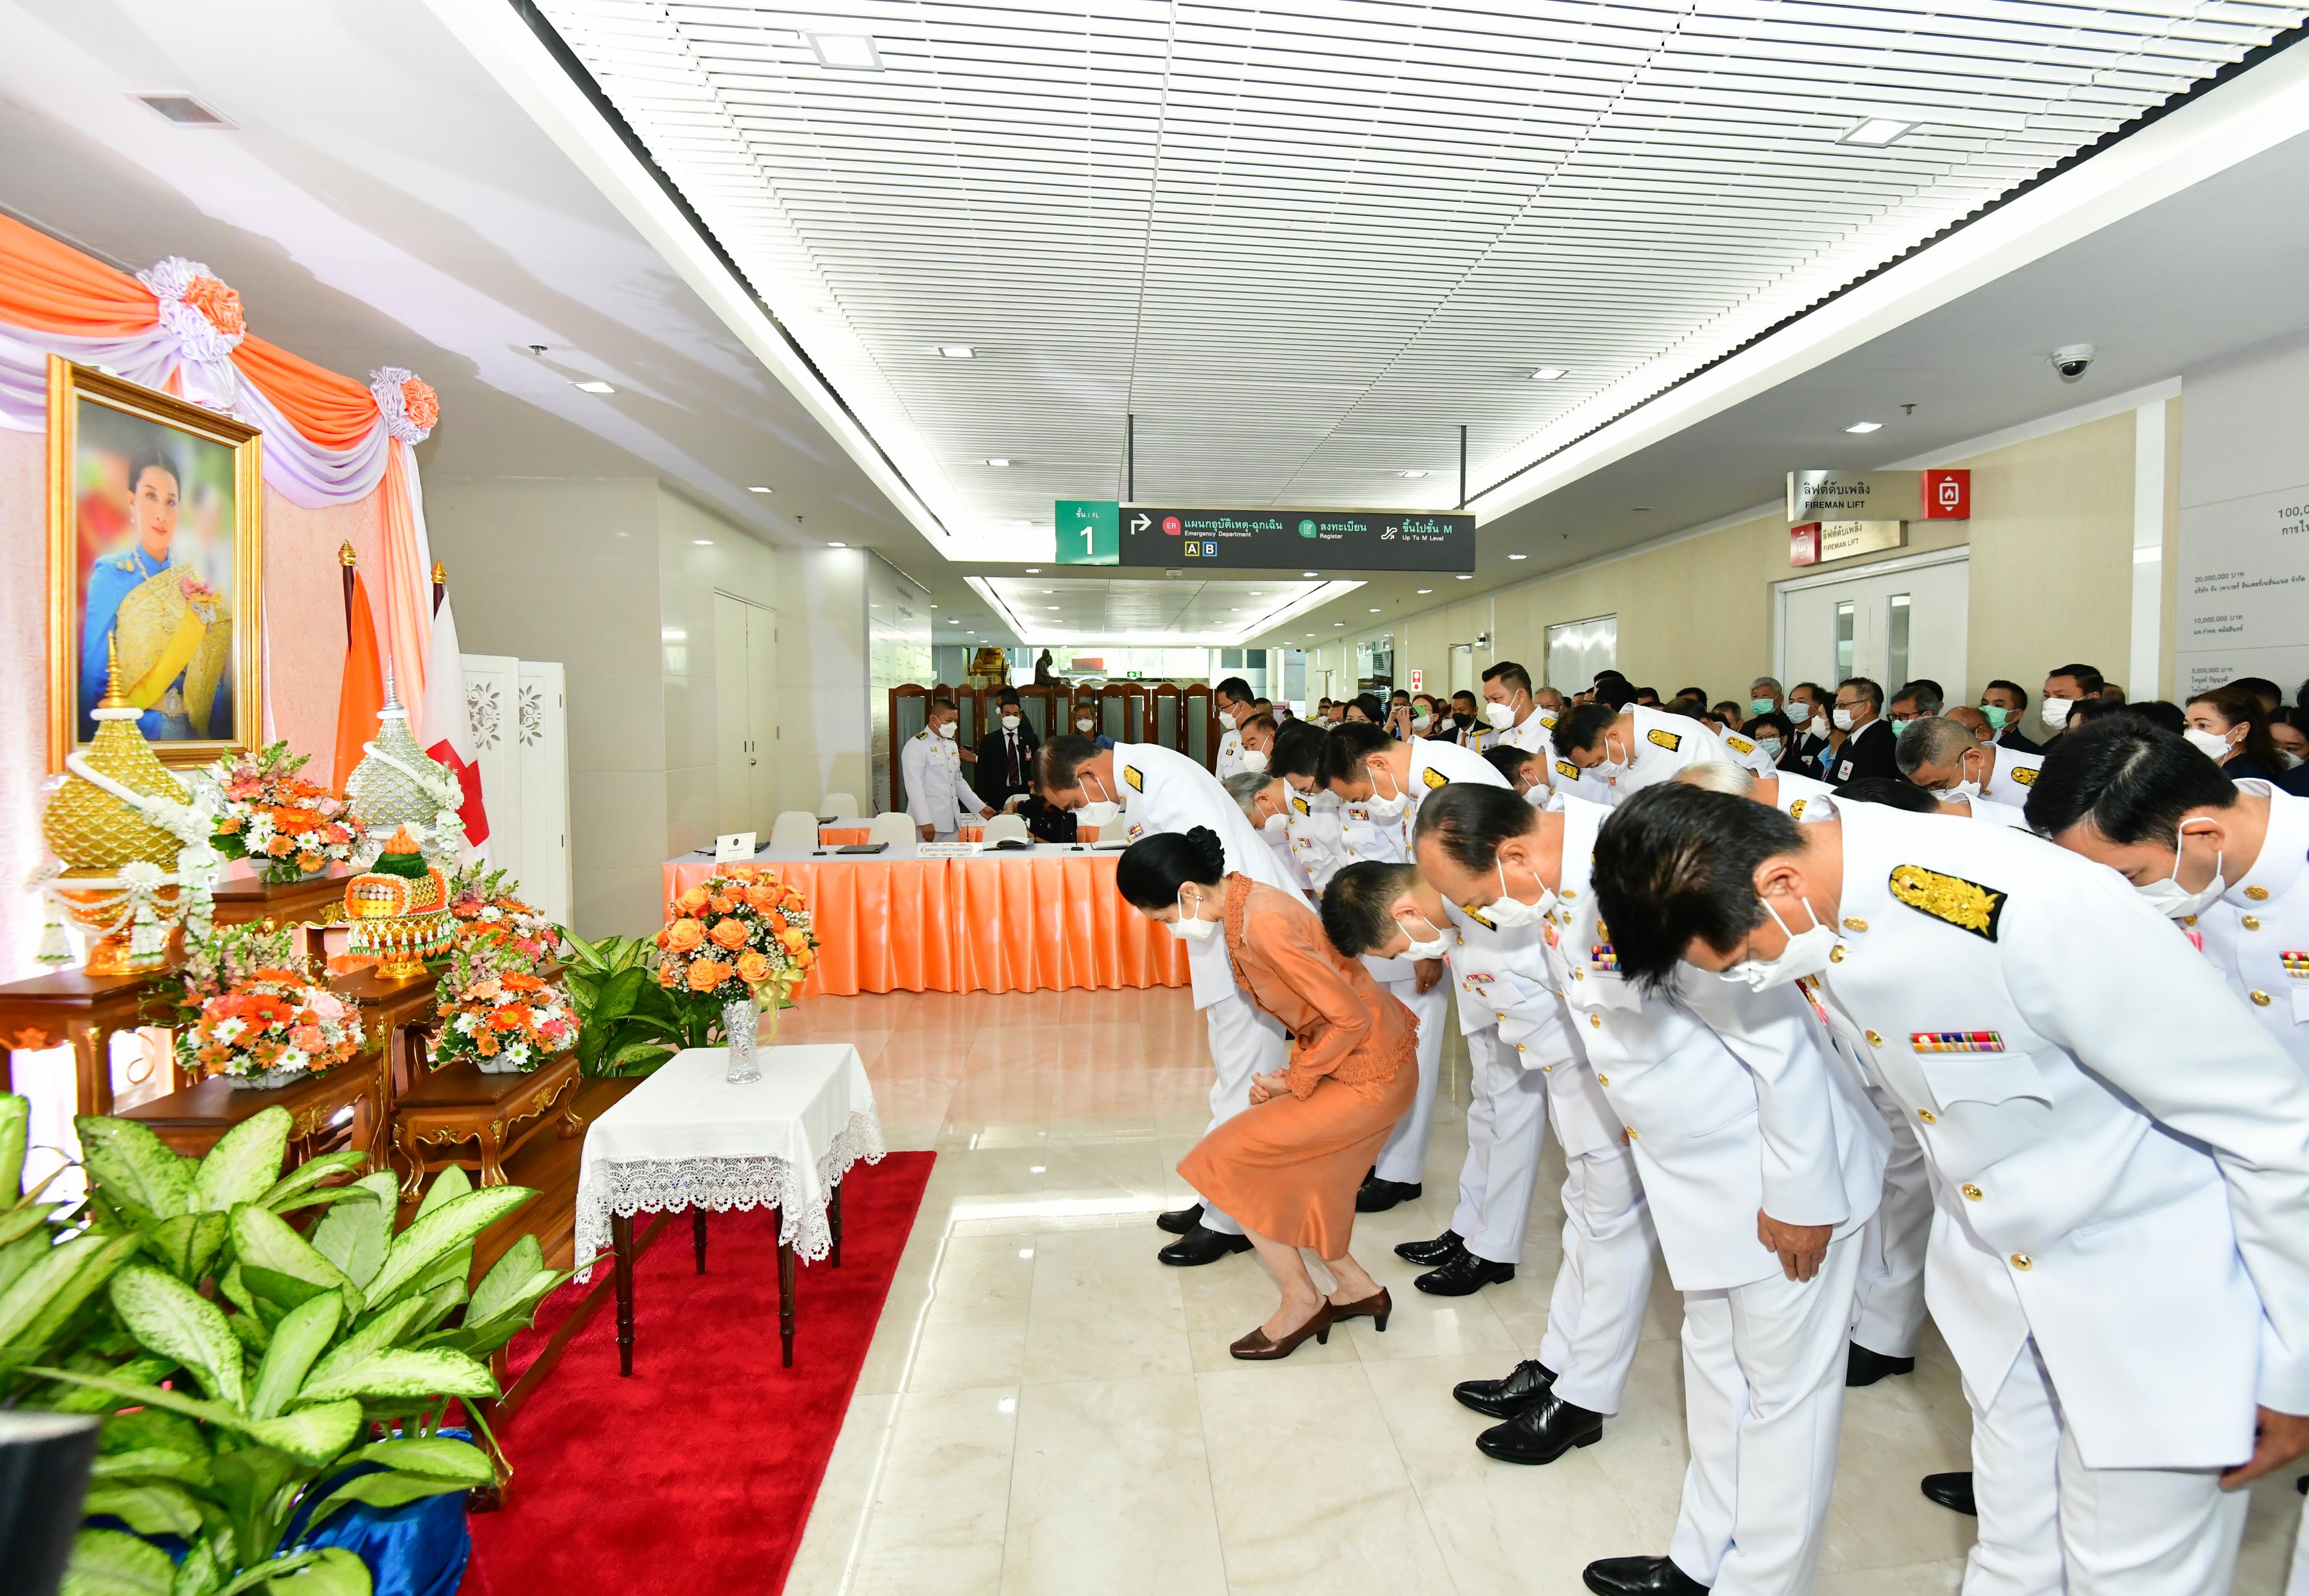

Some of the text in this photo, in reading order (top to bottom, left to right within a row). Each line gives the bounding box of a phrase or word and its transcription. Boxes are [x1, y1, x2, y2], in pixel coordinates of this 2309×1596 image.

[1804, 480, 1870, 495] ลิฟต์ดับเพลิง
[1805, 501, 1844, 509] FIREMAN
[1076, 507, 1086, 518] ชั้น
[1184, 518, 1283, 533] แผนกอุบัติเหตุ-ฉุกเฉิน
[1320, 520, 1367, 532] ลงทะเบียน
[1403, 518, 1453, 534] ขึ้นไปชั้น M
[1080, 526, 1093, 555] 1
[1823, 538, 1859, 552] FIREMAN LIFT
[1187, 544, 1214, 555] A B
[2195, 574, 2229, 583] 20,000,000
[2194, 616, 2228, 624] 10,000,000
